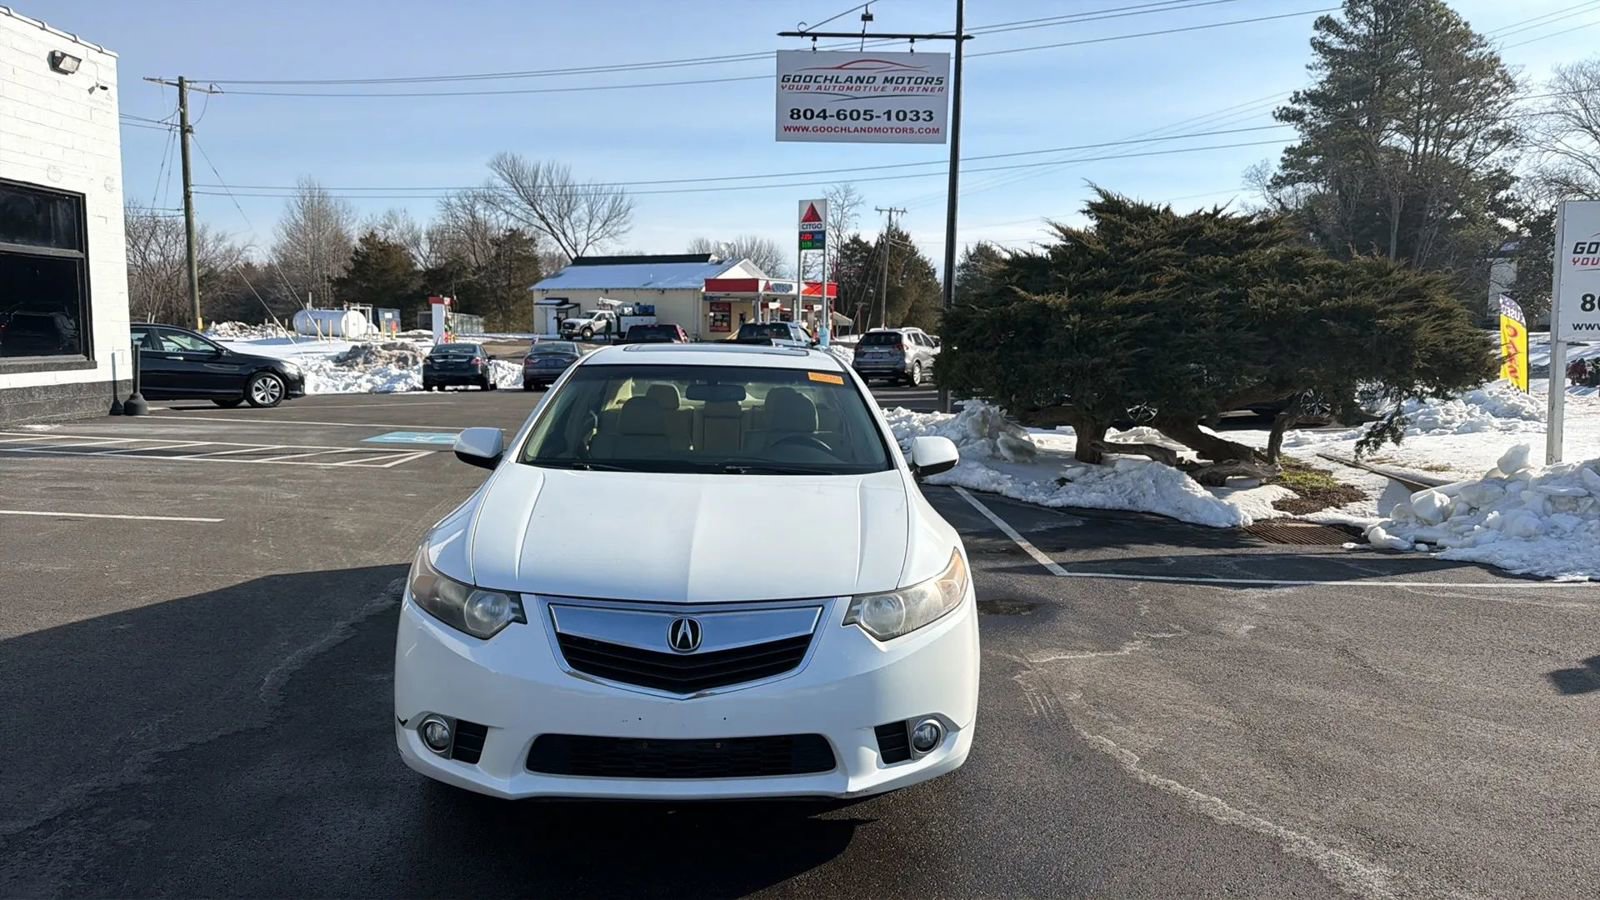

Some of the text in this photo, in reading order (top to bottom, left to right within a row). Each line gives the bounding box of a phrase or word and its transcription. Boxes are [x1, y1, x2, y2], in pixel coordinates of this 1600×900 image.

[781, 74, 945, 86] GOOCHLAND MOTORS
[815, 85, 888, 93] AUTOMOTIVE
[789, 108, 935, 122] 804-605-1033
[783, 125, 941, 135] WWW.GOOCHLANDMOTORS.COM
[1580, 293, 1600, 312] 8
